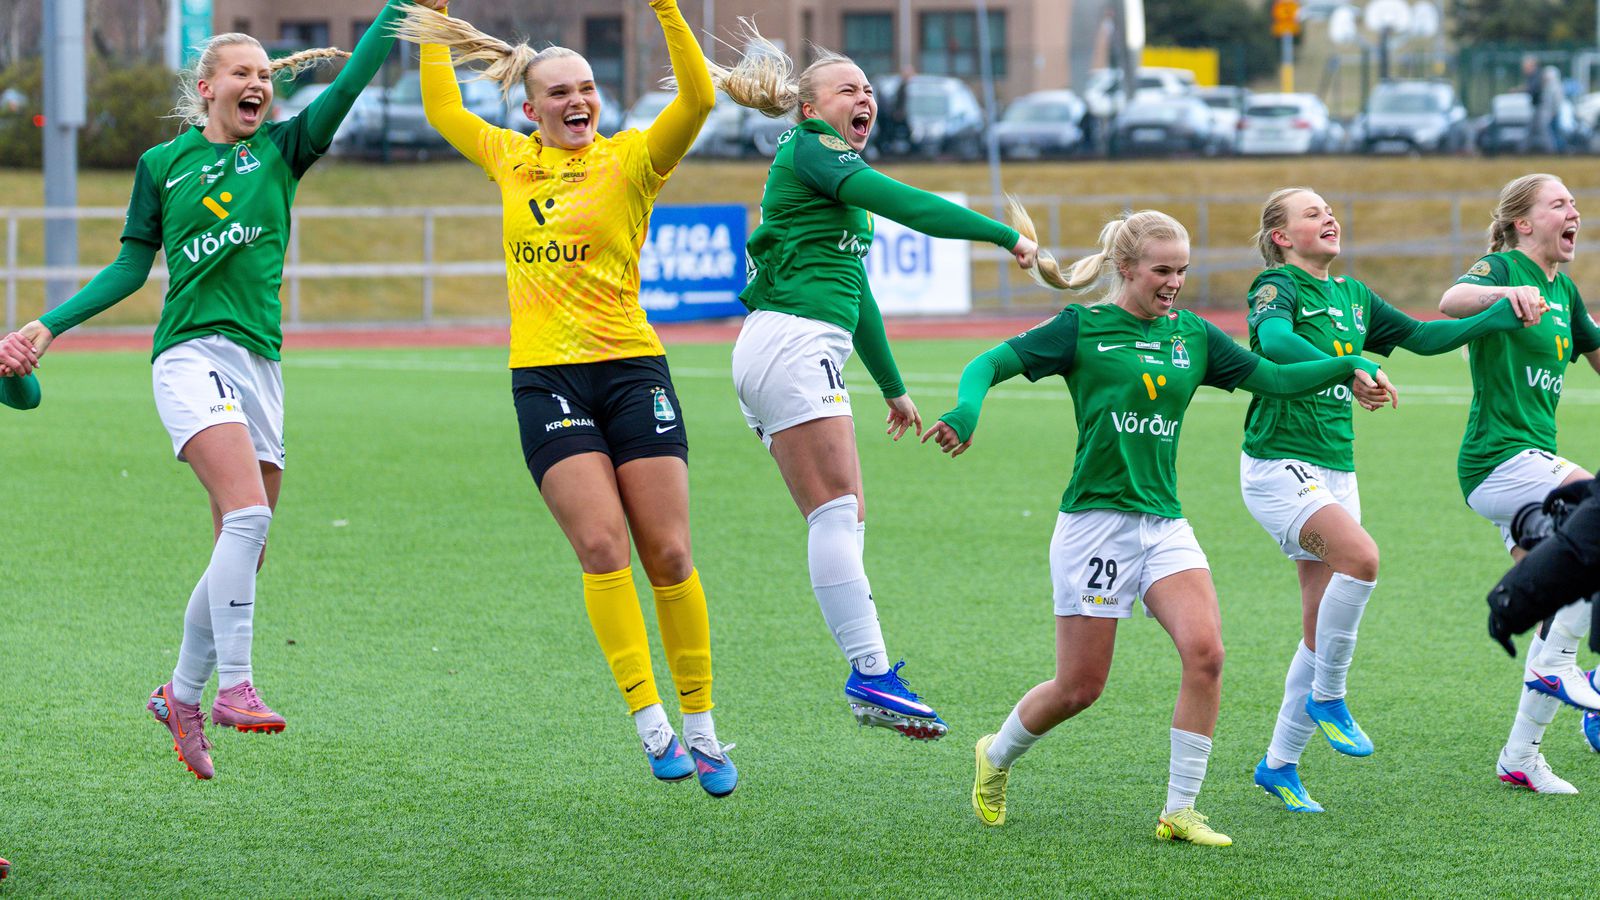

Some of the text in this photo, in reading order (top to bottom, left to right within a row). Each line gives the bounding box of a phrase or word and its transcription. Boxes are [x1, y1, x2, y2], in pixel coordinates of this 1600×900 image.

[182, 222, 262, 262] Vörður
[508, 240, 591, 264] Vörður
[551, 393, 572, 415] 1
[1110, 411, 1179, 436] Vörður
[1087, 557, 1118, 591] 29
